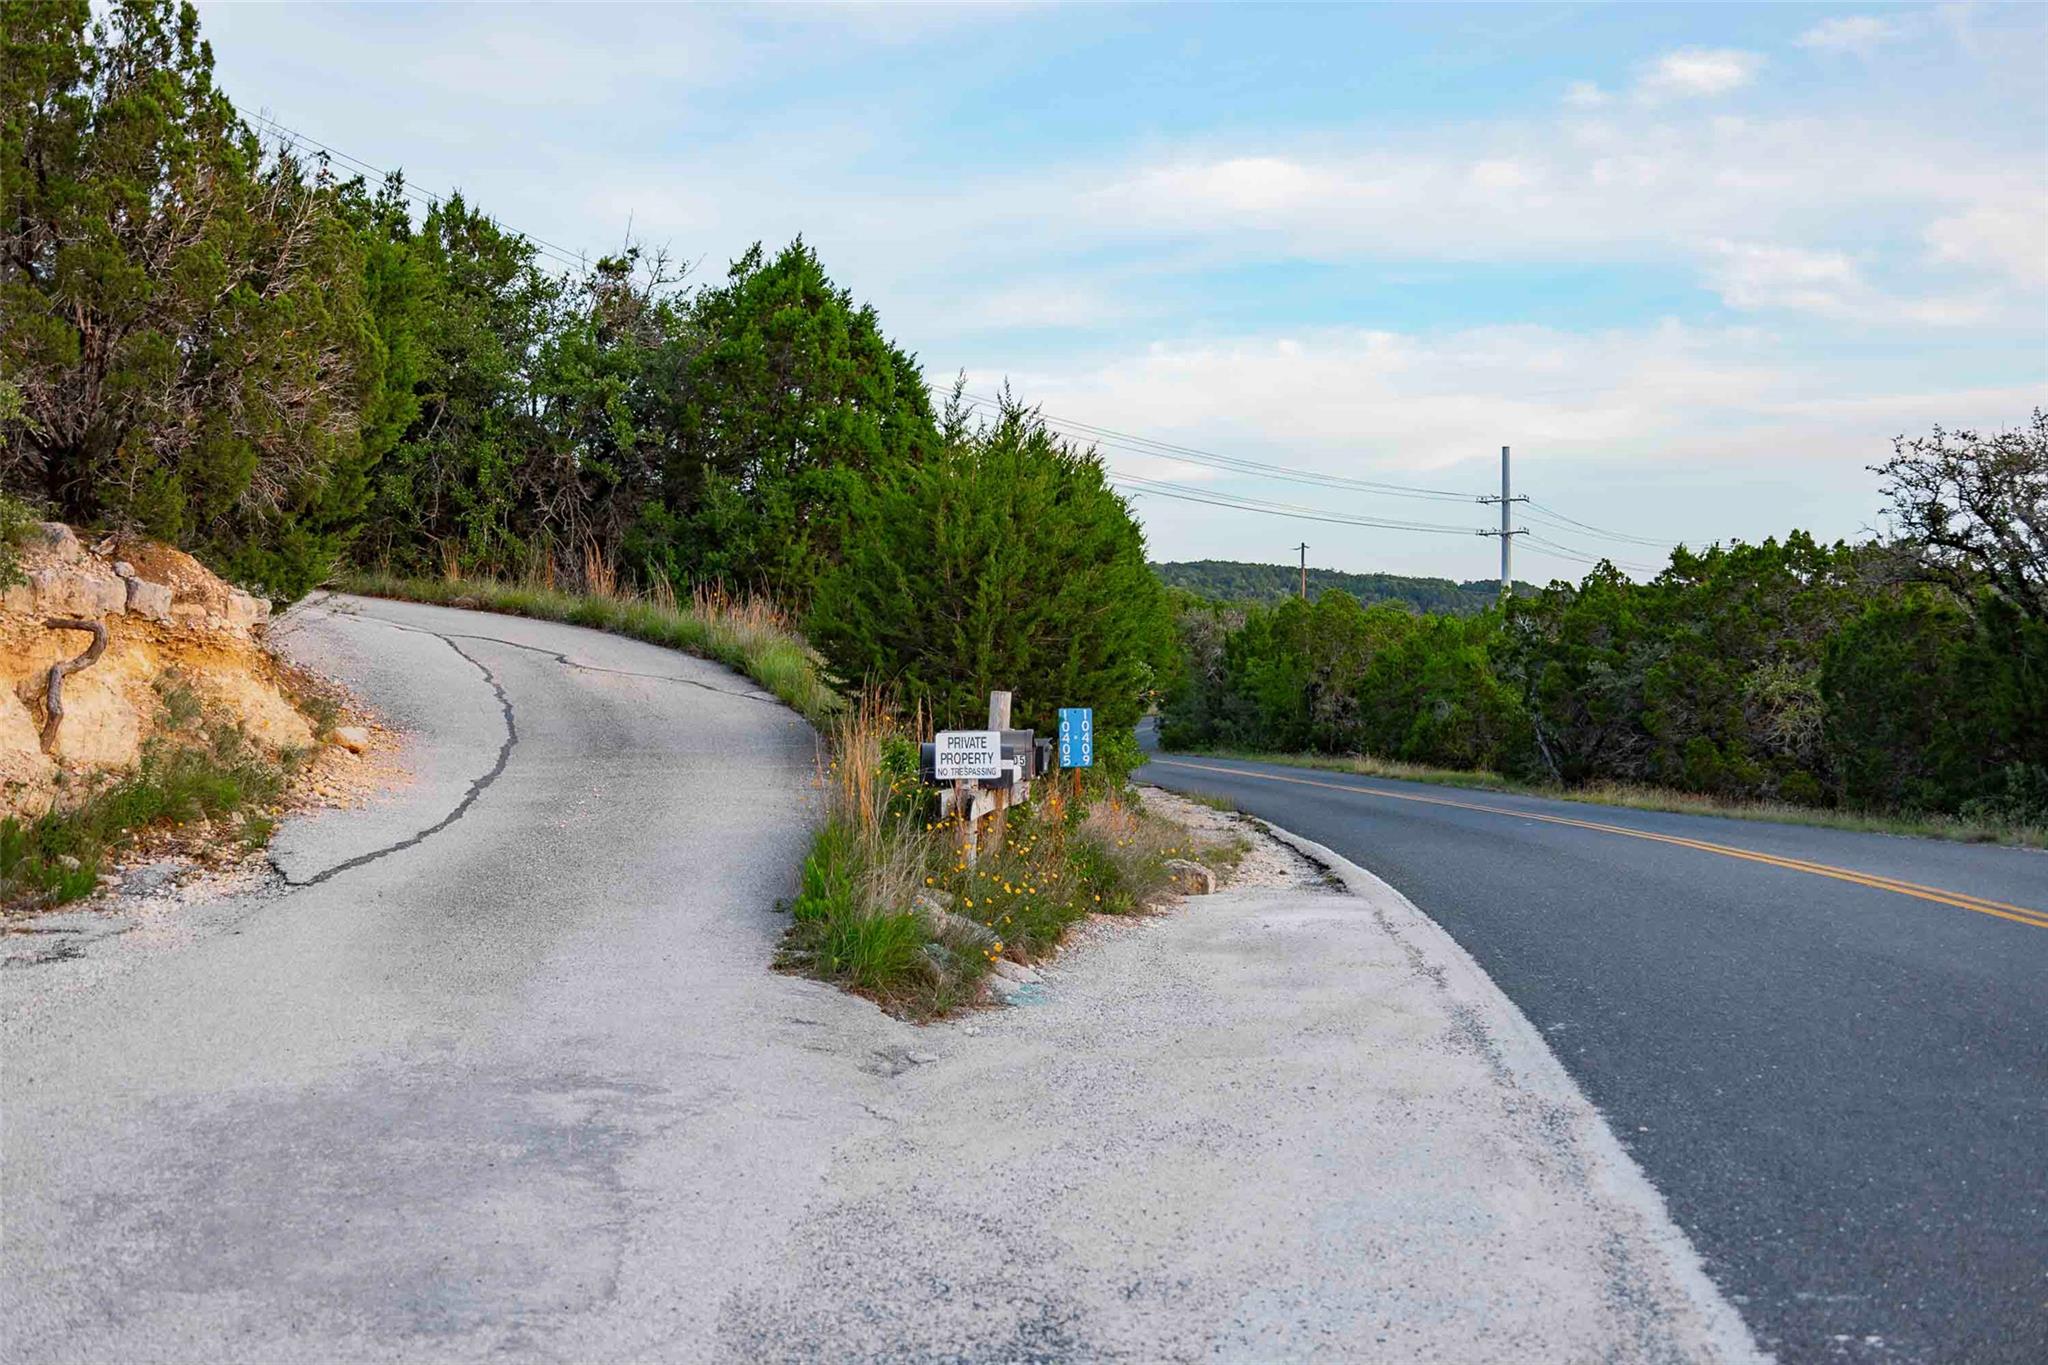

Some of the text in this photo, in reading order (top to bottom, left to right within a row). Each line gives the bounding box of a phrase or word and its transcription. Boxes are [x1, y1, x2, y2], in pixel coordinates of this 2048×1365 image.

[947, 737, 987, 749] PRIVATE
[940, 752, 994, 765] PROPERTY
[937, 767, 997, 776] NO TRESPASSING
